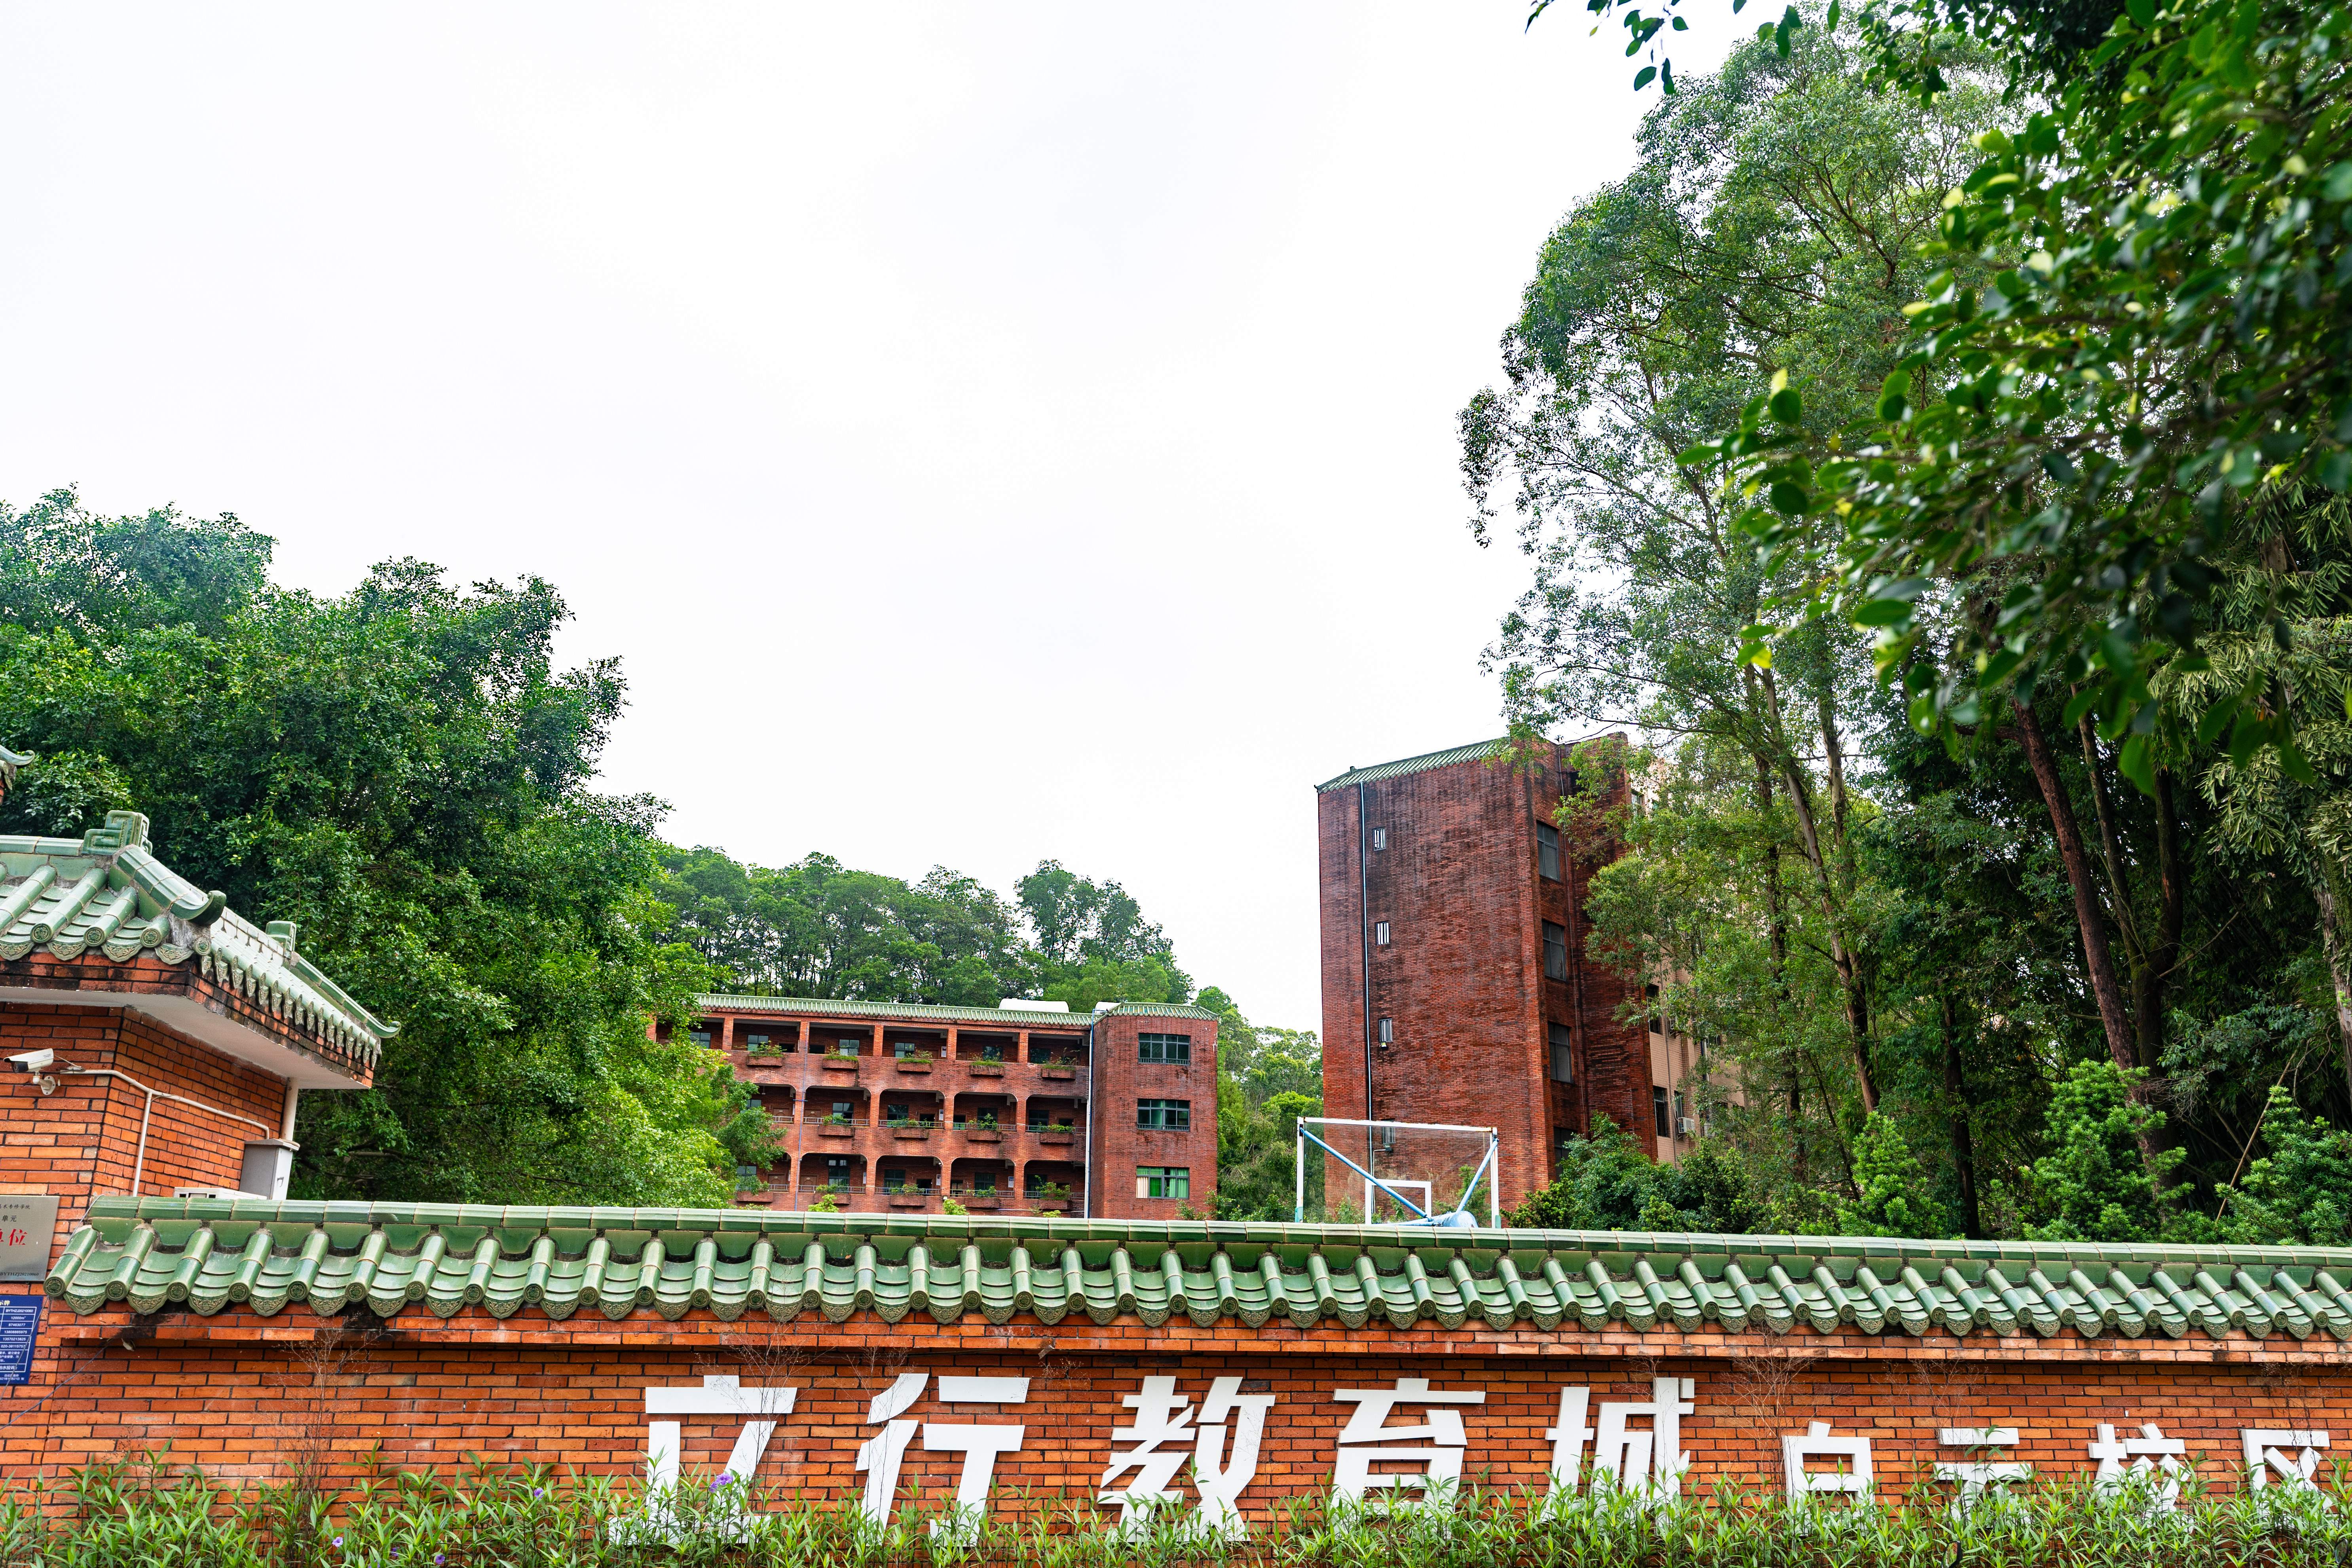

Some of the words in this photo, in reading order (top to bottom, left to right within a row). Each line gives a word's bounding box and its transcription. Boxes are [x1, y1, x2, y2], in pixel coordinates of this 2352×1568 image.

[609, 1372, 1694, 1543] 立行教育城
[1782, 1421, 2337, 1536] 白云校区
